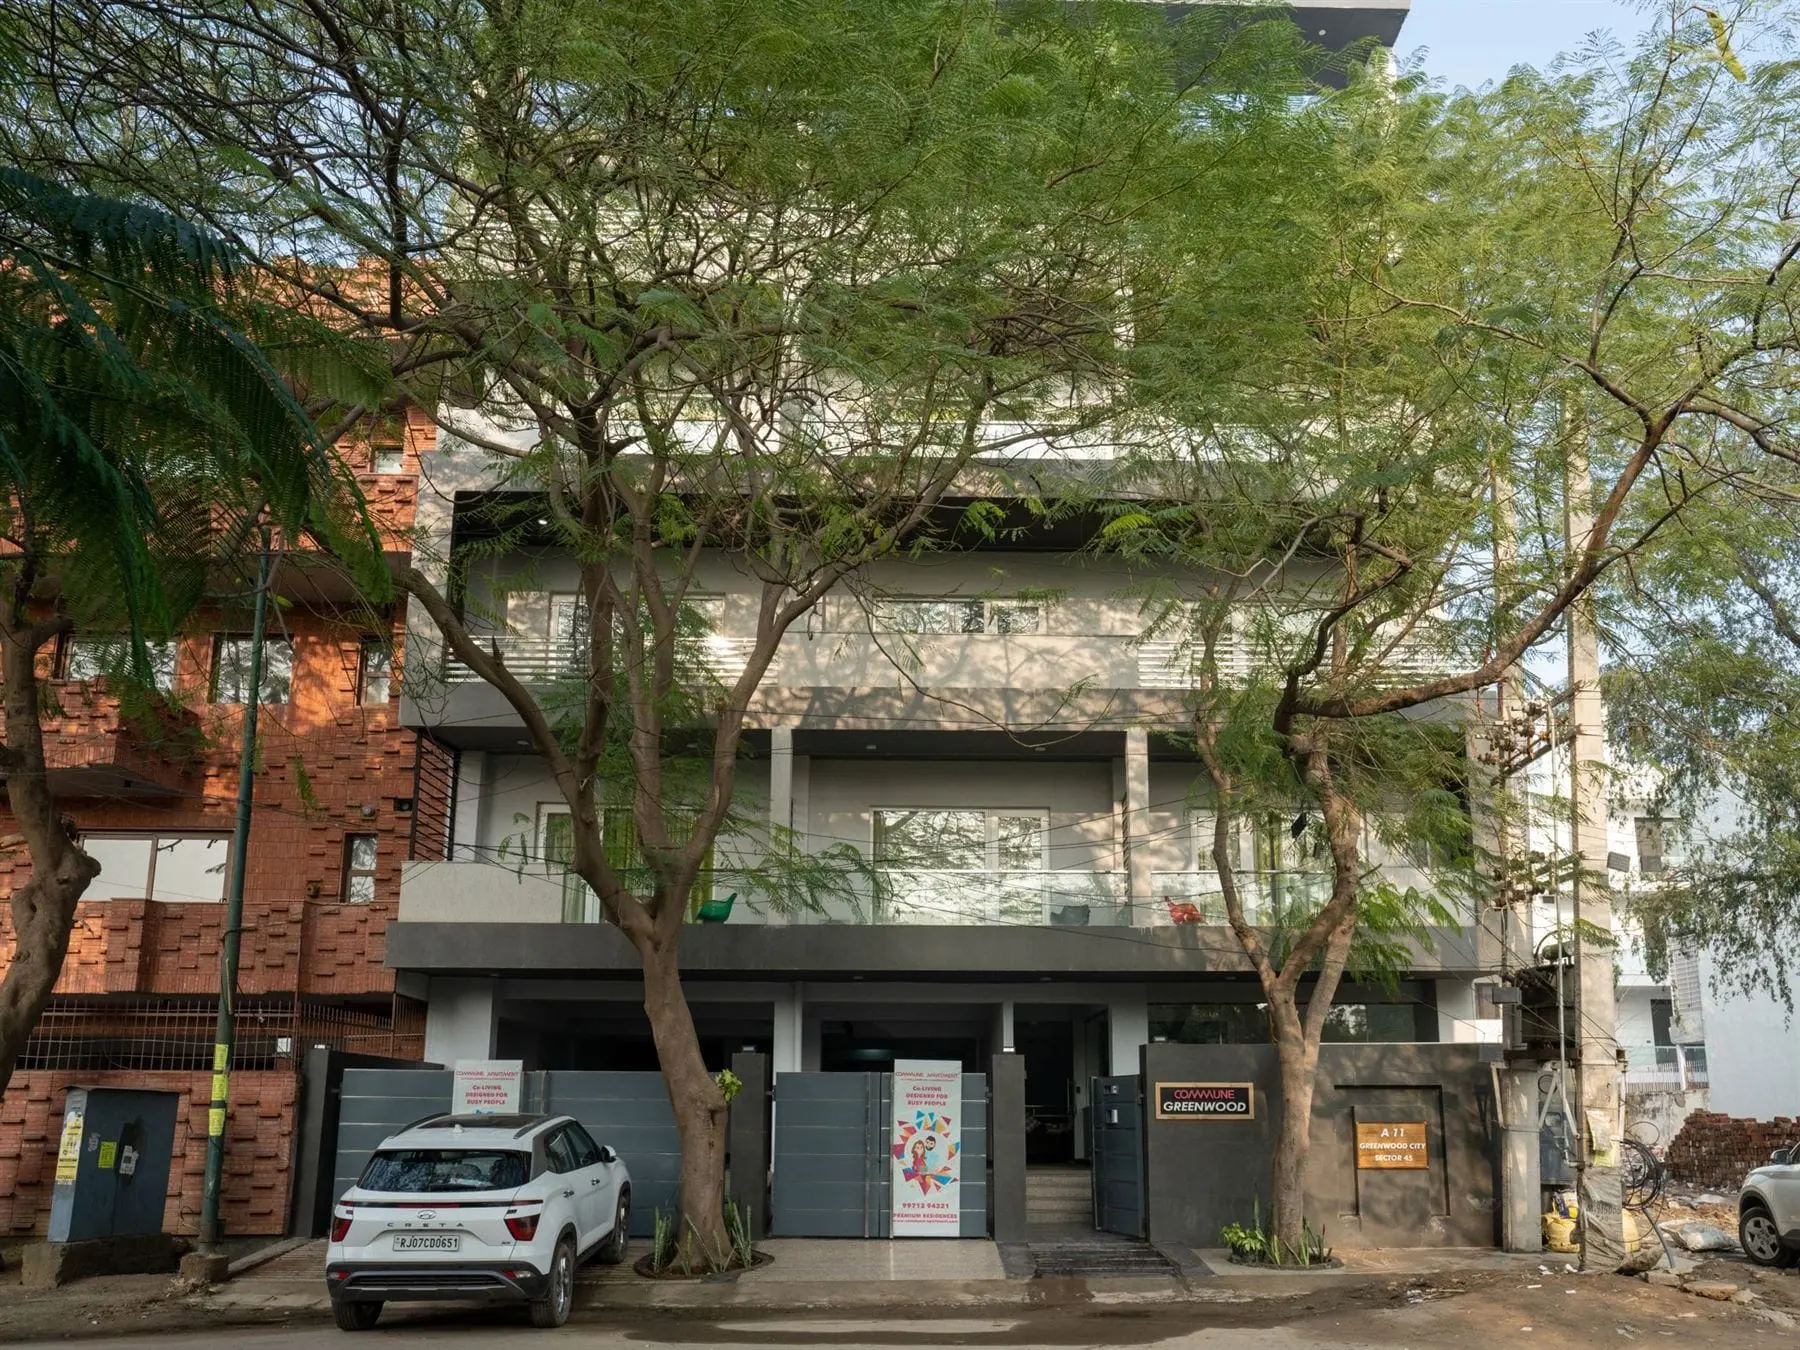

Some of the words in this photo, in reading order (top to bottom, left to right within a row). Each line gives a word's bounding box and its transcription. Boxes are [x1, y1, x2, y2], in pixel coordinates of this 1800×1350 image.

[1174, 1089, 1236, 1100] COMMUNE
[1163, 1101, 1247, 1112] GREENWOOD
[1380, 1128, 1390, 1138] A
[1393, 1128, 1405, 1138] 11
[1360, 1142, 1408, 1150] GREENWOOD
[1409, 1142, 1426, 1150] CITY
[1375, 1154, 1402, 1162] SECTOR
